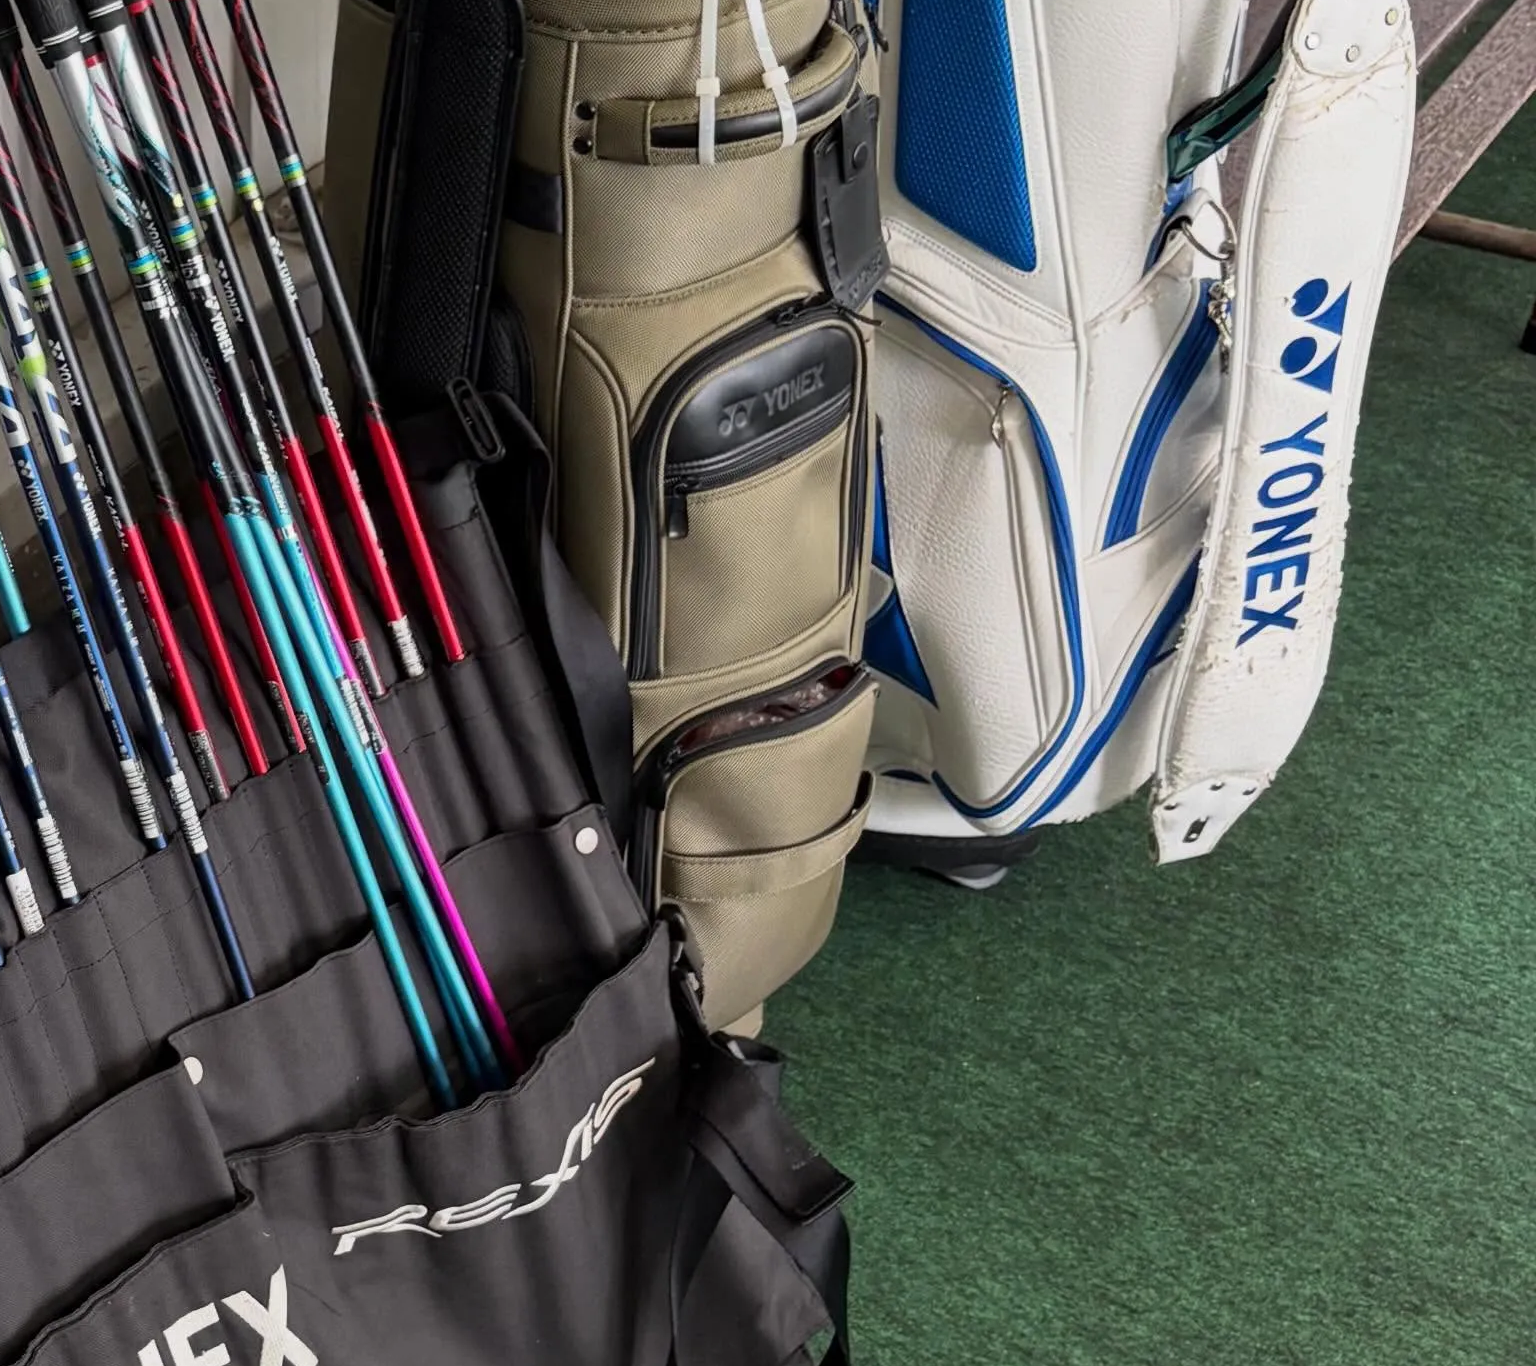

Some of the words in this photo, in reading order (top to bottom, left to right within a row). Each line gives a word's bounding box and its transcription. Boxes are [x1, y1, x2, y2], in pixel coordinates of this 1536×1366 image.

[206, 310, 237, 357] YONEX
[55, 362, 81, 408] YONEX
[764, 362, 825, 417] YONEX
[25, 481, 50, 523] YONEX
[50, 553, 75, 602] KAIZA
[79, 494, 103, 538] YONEX
[1234, 411, 1329, 649] YONEX
